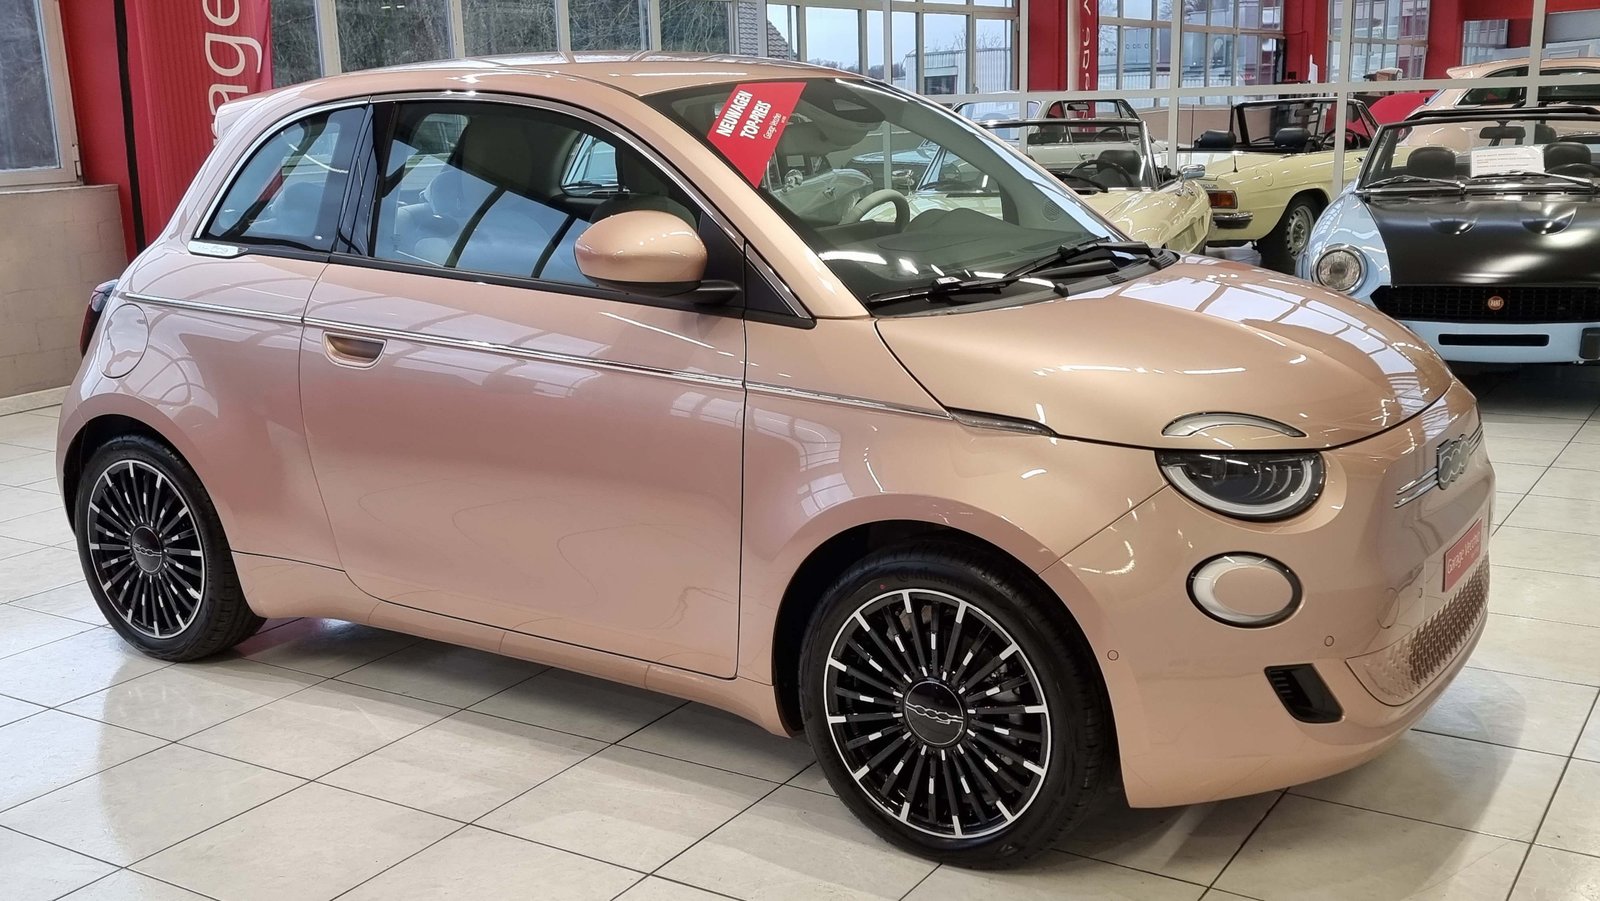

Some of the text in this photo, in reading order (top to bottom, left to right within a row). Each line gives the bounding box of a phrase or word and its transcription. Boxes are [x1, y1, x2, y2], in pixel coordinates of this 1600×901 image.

[203, 0, 262, 143] age
[716, 90, 753, 137] NEUWAGEN
[740, 100, 771, 139] TOP-PREIS
[1438, 437, 1470, 485] 500
[1447, 549, 1464, 574] Garage
